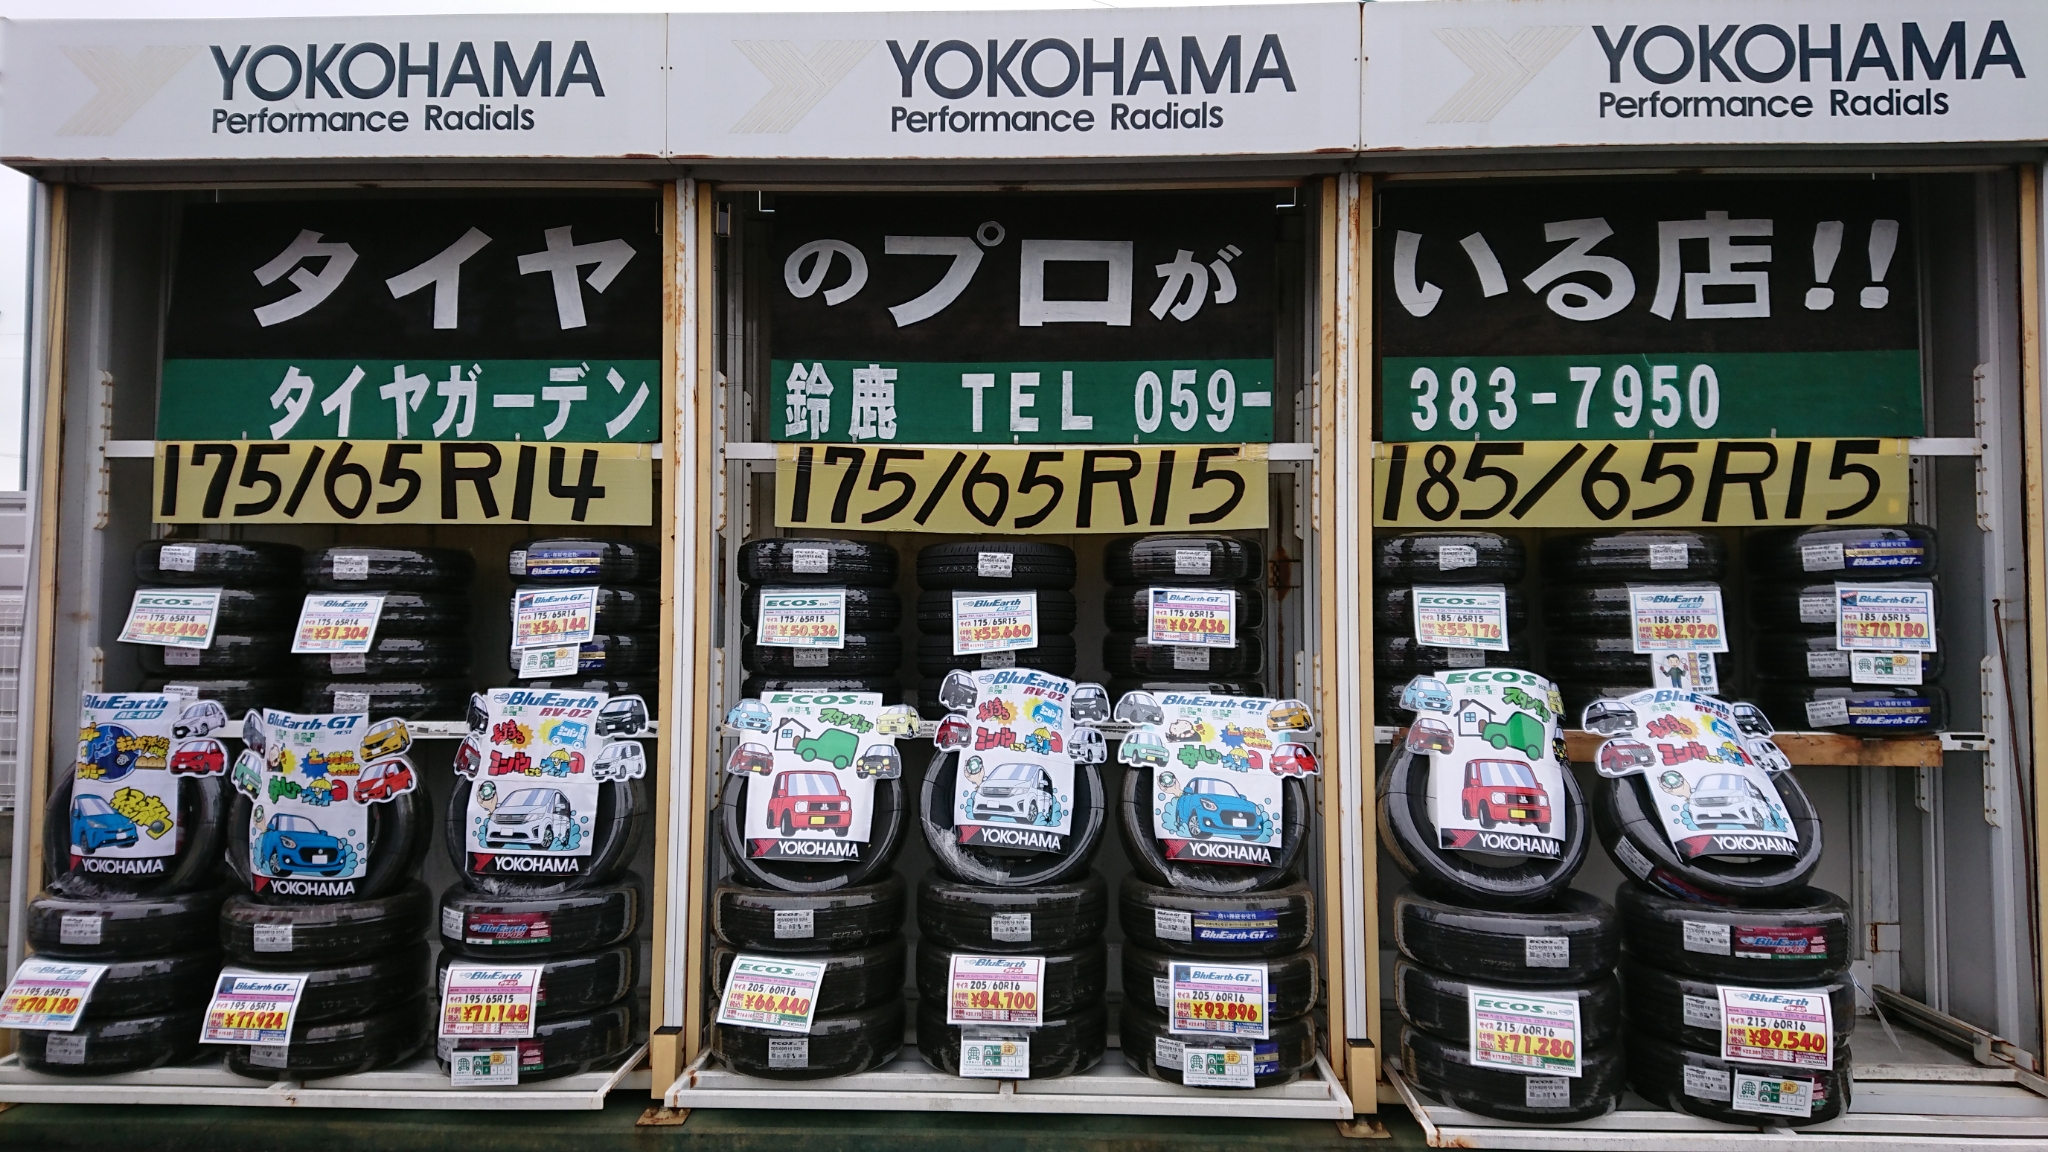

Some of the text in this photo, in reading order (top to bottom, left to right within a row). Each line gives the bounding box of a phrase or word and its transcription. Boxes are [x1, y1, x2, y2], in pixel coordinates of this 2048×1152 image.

[1592, 20, 2026, 85] YOKOHAMA
[209, 40, 606, 100] YOKOHAMA
[886, 34, 1297, 99] YOKOHAMA
[1599, 87, 1950, 118] Performance Radials
[212, 104, 535, 134] Performance Radials
[891, 102, 1224, 133] Performance Radials
[253, 225, 637, 330] タイヤ
[784, 220, 1243, 328] のプロが
[269, 361, 650, 440] タイヤガーデン
[785, 361, 1272, 440] 鈴鹿 TEL 059-
[1410, 363, 1721, 432] 383-7950
[160, 441, 606, 522] 175/65R14
[790, 446, 1248, 530] 175/65R15
[1382, 439, 1882, 522] 185/65R15
[1853, 557, 1917, 566] BluEarth-GT
[531, 566, 589, 575] BluEarth-GT
[140, 597, 192, 606] ECOS
[324, 600, 368, 608] BluEarth
[534, 593, 584, 604] BluEarth-GT
[974, 599, 1021, 608] BluEarth
[1169, 594, 1221, 603] BluEarth-GT
[1420, 597, 1476, 605] ECOS
[1653, 595, 1705, 603] BluEarth
[1858, 594, 1918, 604] BluEarth-GT
[149, 614, 195, 622] 175/65R14
[534, 610, 576, 620] 175/65R14
[780, 615, 825, 623] 175/65R15
[1169, 609, 1215, 618] 175/65R15
[1436, 614, 1484, 623] 185/65R15
[1654, 615, 1702, 624] 185/65R15
[1860, 613, 1910, 622] 185/65R15
[145, 622, 208, 637] ¥45,496
[317, 618, 359, 626] 175/65R14
[533, 617, 587, 634] ¥56,144
[973, 618, 1017, 627] 175/65R15
[1169, 618, 1226, 633] ¥62,436
[314, 627, 370, 640] ¥51,304
[779, 624, 837, 637] ¥50,336
[974, 624, 1031, 641] ¥55,660
[1437, 623, 1501, 638] ¥55,176
[1655, 624, 1718, 639] ¥62,920
[1860, 622, 1925, 638] ¥70,180
[993, 671, 1070, 694] BluEarth
[1446, 671, 1537, 686] ECOS
[507, 691, 600, 708] BluEarth
[770, 694, 858, 705] ECOS
[1023, 686, 1065, 702] RV-02
[83, 695, 169, 709] BluEarth
[1161, 694, 1271, 711] BluEarth-GT
[1654, 690, 1730, 714] BluEarth
[117, 710, 162, 719] AE-01F
[539, 708, 593, 718] RV-02
[818, 708, 874, 733] スタンダード
[1856, 716, 1922, 725] BluEarth-GT
[267, 712, 363, 730] BluEarth-GT
[981, 828, 1061, 850] YOKOHAMA
[1478, 832, 1561, 856] YOKOHAMA
[1713, 835, 1798, 854] YOKOHAMA
[778, 840, 859, 857] YOKOHAMA
[1189, 842, 1272, 863] YOKOHAMA
[82, 858, 164, 874] YOKOHAMA
[494, 856, 579, 872] YOKOHAMA
[270, 881, 355, 896] YOKOHAMA
[478, 924, 528, 932] BluEarth
[1200, 930, 1268, 939] BluEarth-GT
[1754, 937, 1808, 947] BluEarth
[738, 963, 795, 975] ECOS
[975, 958, 1026, 967] BluEarth
[470, 972, 523, 980] BluEarth
[1192, 970, 1252, 981] BluEarth-GT
[25, 987, 70, 996] 195/65R15
[235, 982, 290, 991] BluEarth-GT
[747, 983, 796, 996] 205/60R16
[970, 981, 1020, 990] 205/60R16
[465, 994, 514, 1004] 195/65R15
[971, 991, 1035, 1009] ¥84,700
[1192, 991, 1244, 1002] 205/60R16
[1748, 993, 1809, 1006] BluEarth
[16, 997, 79, 1014] ¥70,180
[230, 1002, 276, 1010] 195/65R15
[745, 994, 810, 1015] ¥66,440
[1193, 1001, 1257, 1021] ¥93,896
[1477, 999, 1545, 1013] ECOS
[225, 1011, 284, 1029] ¥77,924
[463, 1004, 528, 1021] ¥71,148
[1496, 1022, 1555, 1037] 215/60R16
[1747, 1017, 1806, 1031] 215/60R16
[1497, 1034, 1574, 1058] ¥71,280
[1749, 1028, 1825, 1052] ¥89,540
